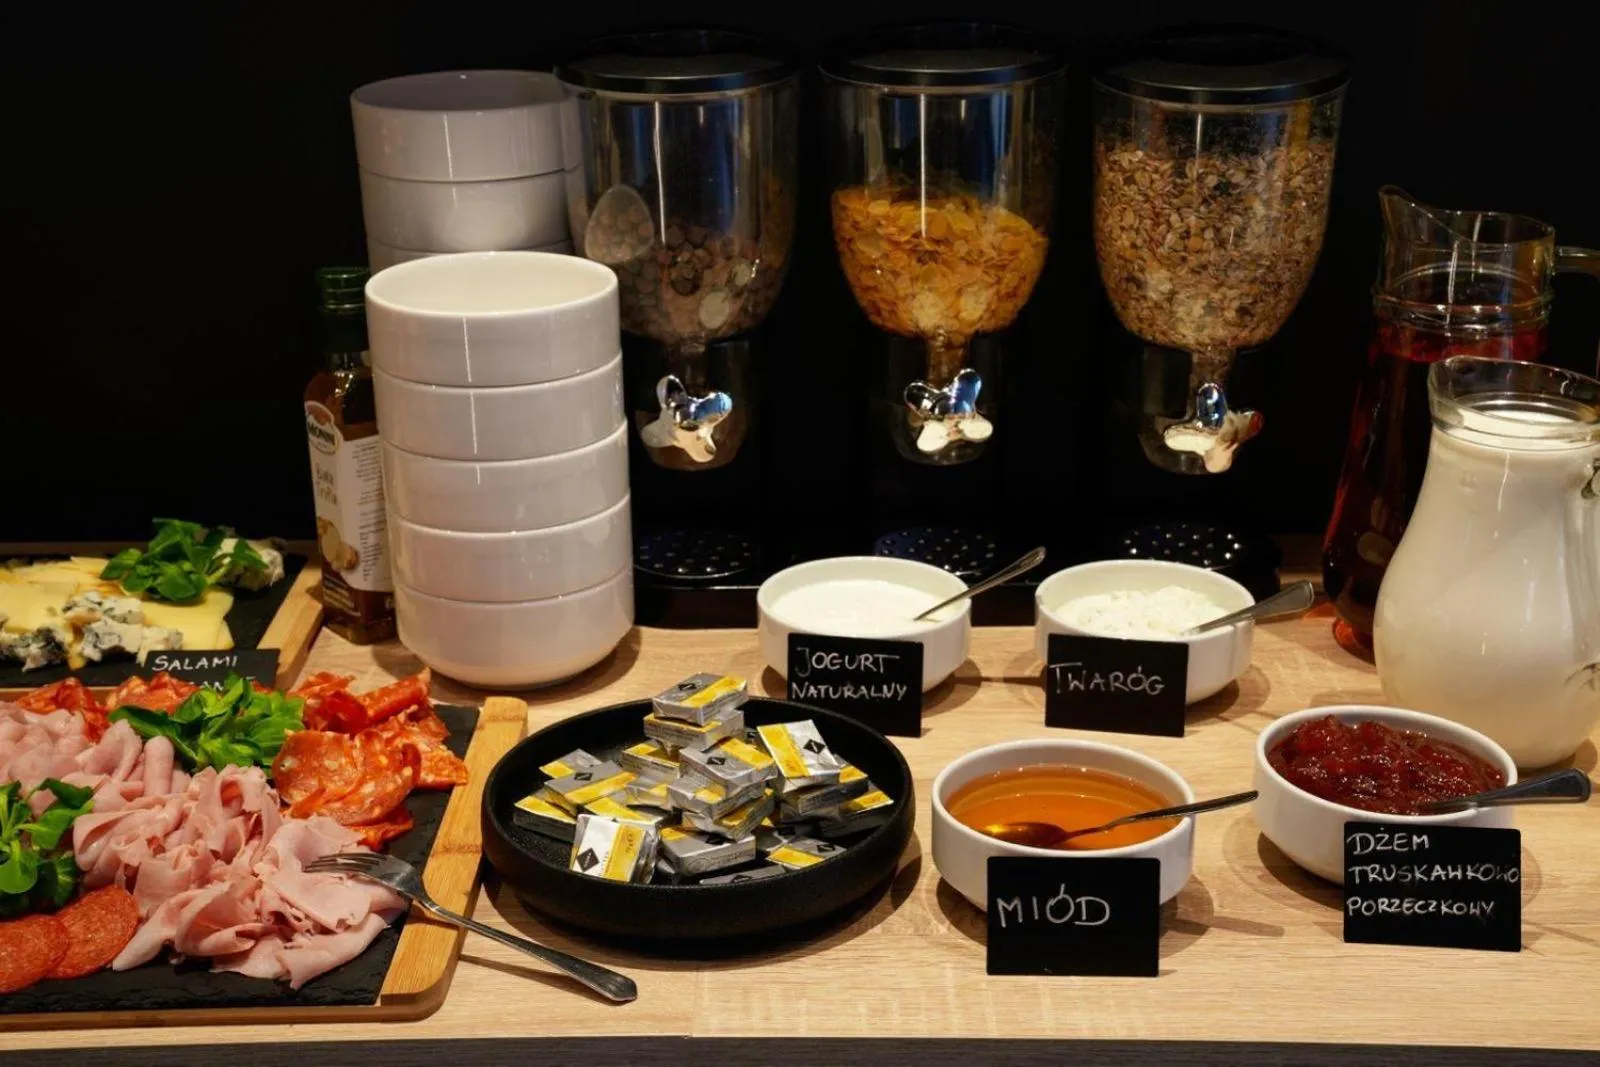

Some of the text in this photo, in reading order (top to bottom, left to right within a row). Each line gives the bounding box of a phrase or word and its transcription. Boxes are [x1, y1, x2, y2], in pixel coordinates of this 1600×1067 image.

[152, 655, 238, 671] SALAMI
[795, 647, 901, 677] JOGURT
[792, 681, 907, 702] NATURALNY
[1049, 661, 1165, 695] TWARÓG
[1346, 827, 1430, 855] DŻEM
[997, 883, 1111, 928] MIÓD
[1347, 896, 1496, 916] PORZECZKOWY
